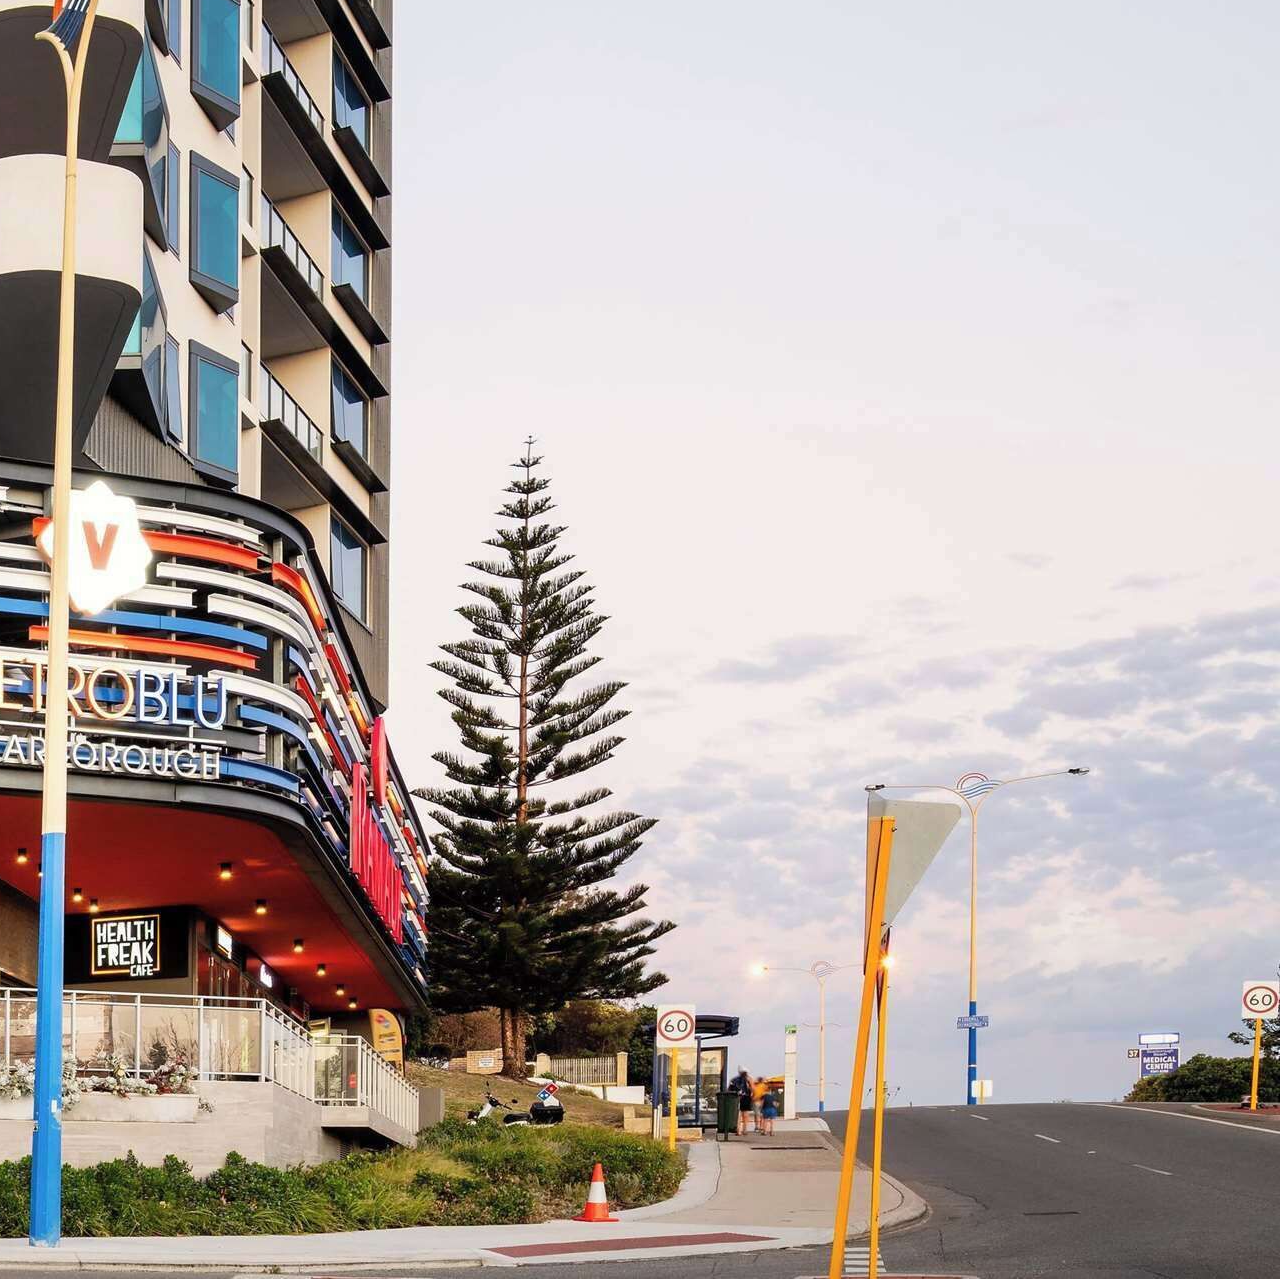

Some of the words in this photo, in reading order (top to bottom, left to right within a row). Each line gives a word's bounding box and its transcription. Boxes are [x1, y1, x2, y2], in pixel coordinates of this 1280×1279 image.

[82, 520, 119, 570] V
[96, 920, 154, 944] HEALTH
[97, 941, 154, 967] FREAK
[130, 964, 154, 977] CAFE
[1249, 993, 1273, 1006] 60
[664, 1018, 688, 1033] 60
[1128, 1050, 1138, 1058] 37
